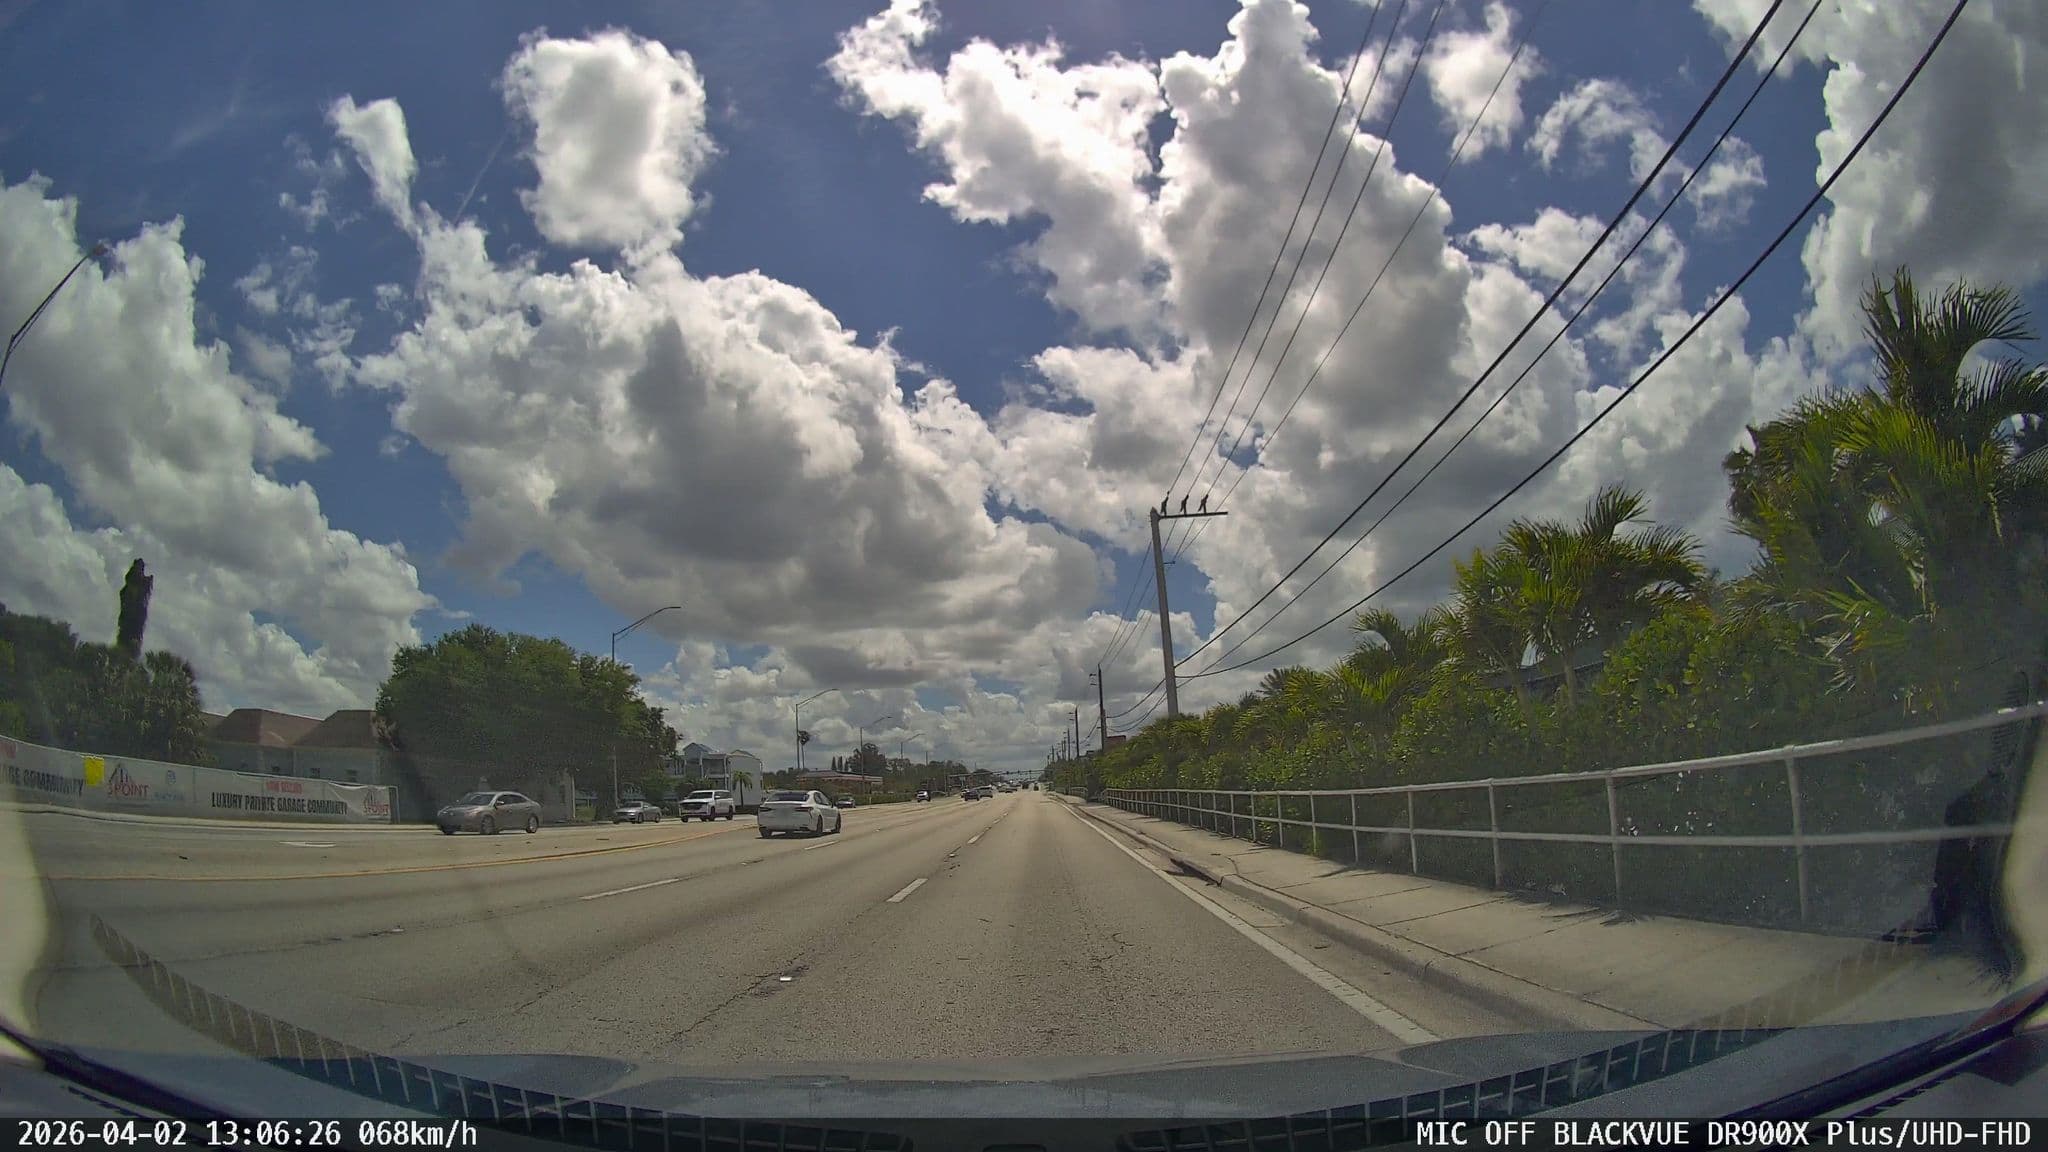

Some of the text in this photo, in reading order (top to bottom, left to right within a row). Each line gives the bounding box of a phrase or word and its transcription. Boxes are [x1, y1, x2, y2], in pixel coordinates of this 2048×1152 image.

[212, 792, 348, 816] LUXURY PRIVATE GARAGE COMMUNITY
